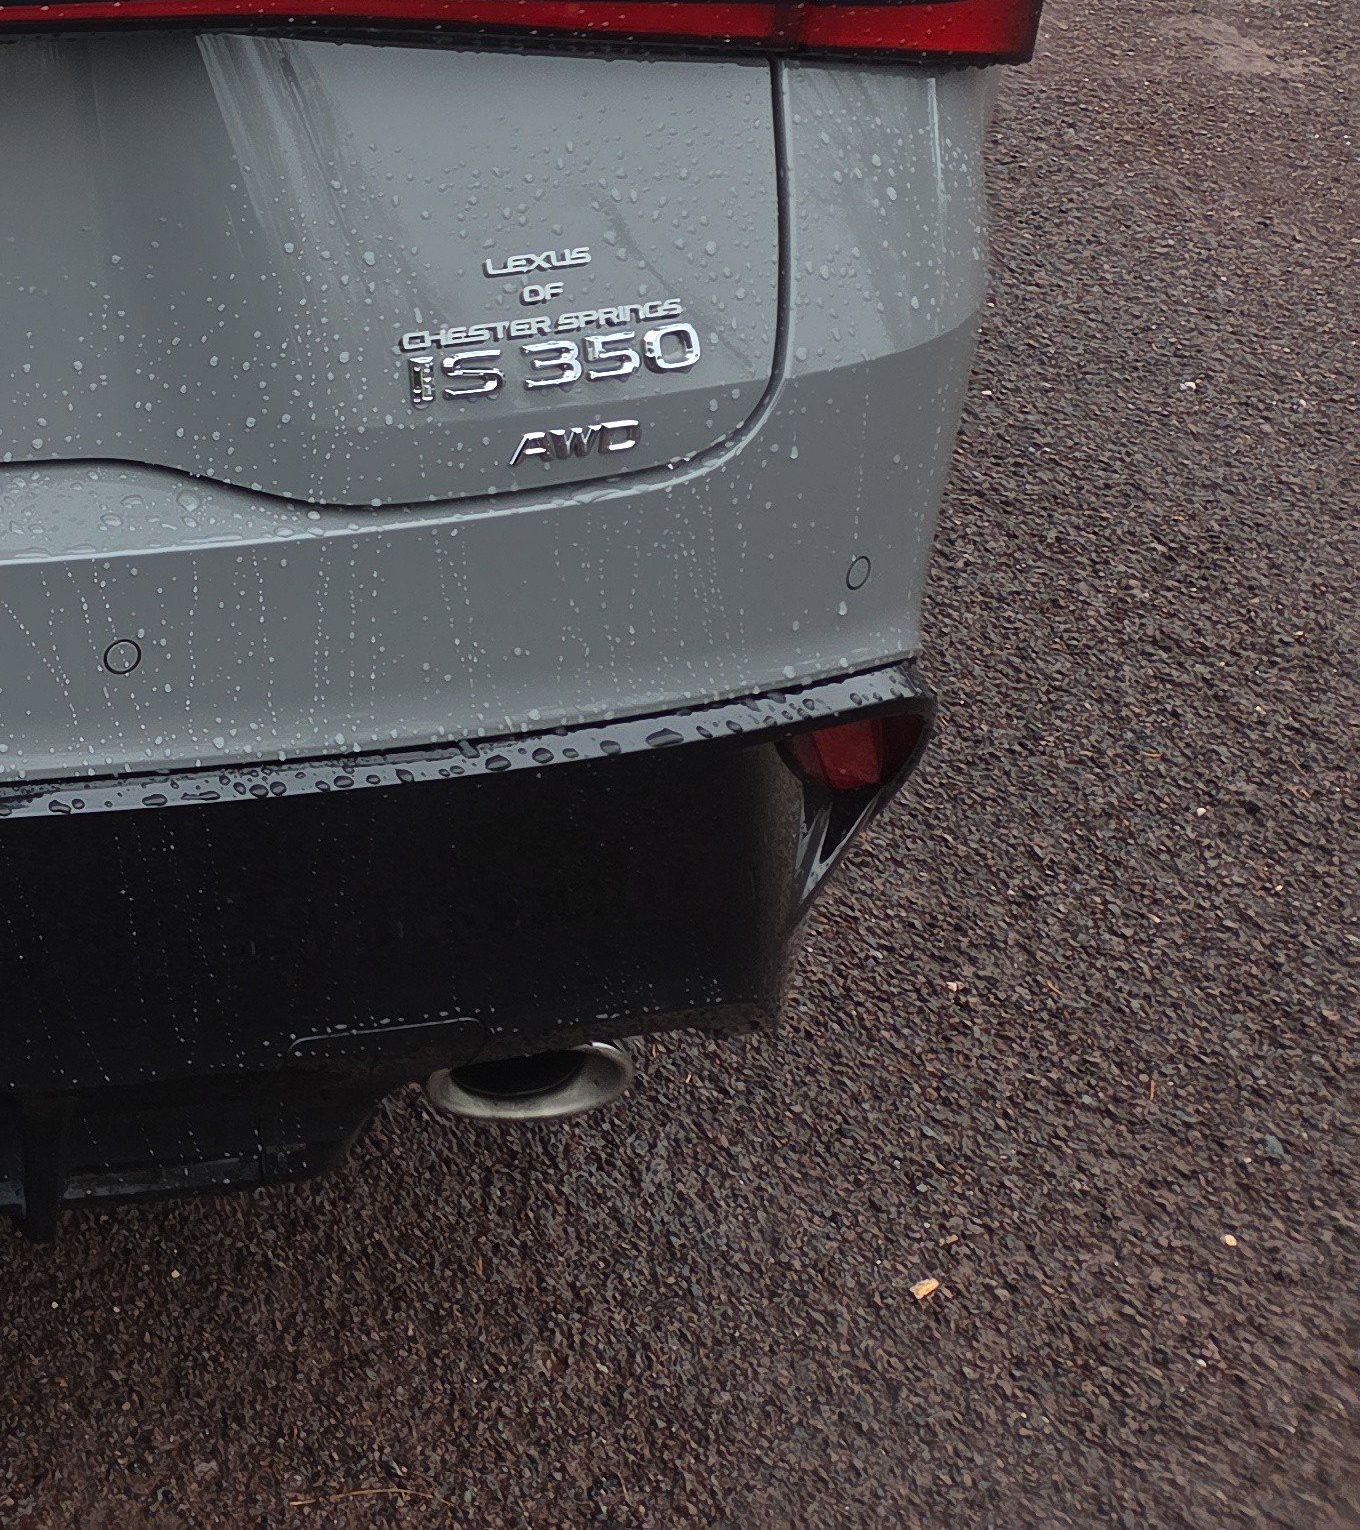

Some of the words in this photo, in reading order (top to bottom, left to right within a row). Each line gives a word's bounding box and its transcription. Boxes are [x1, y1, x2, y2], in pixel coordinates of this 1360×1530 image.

[484, 246, 592, 277] LEXUS
[520, 281, 564, 305] OF
[400, 316, 553, 351] CHESTER
[556, 297, 685, 333] SPRINGS
[408, 349, 506, 409] IS
[521, 322, 701, 391] 350
[508, 419, 641, 467] AWD
